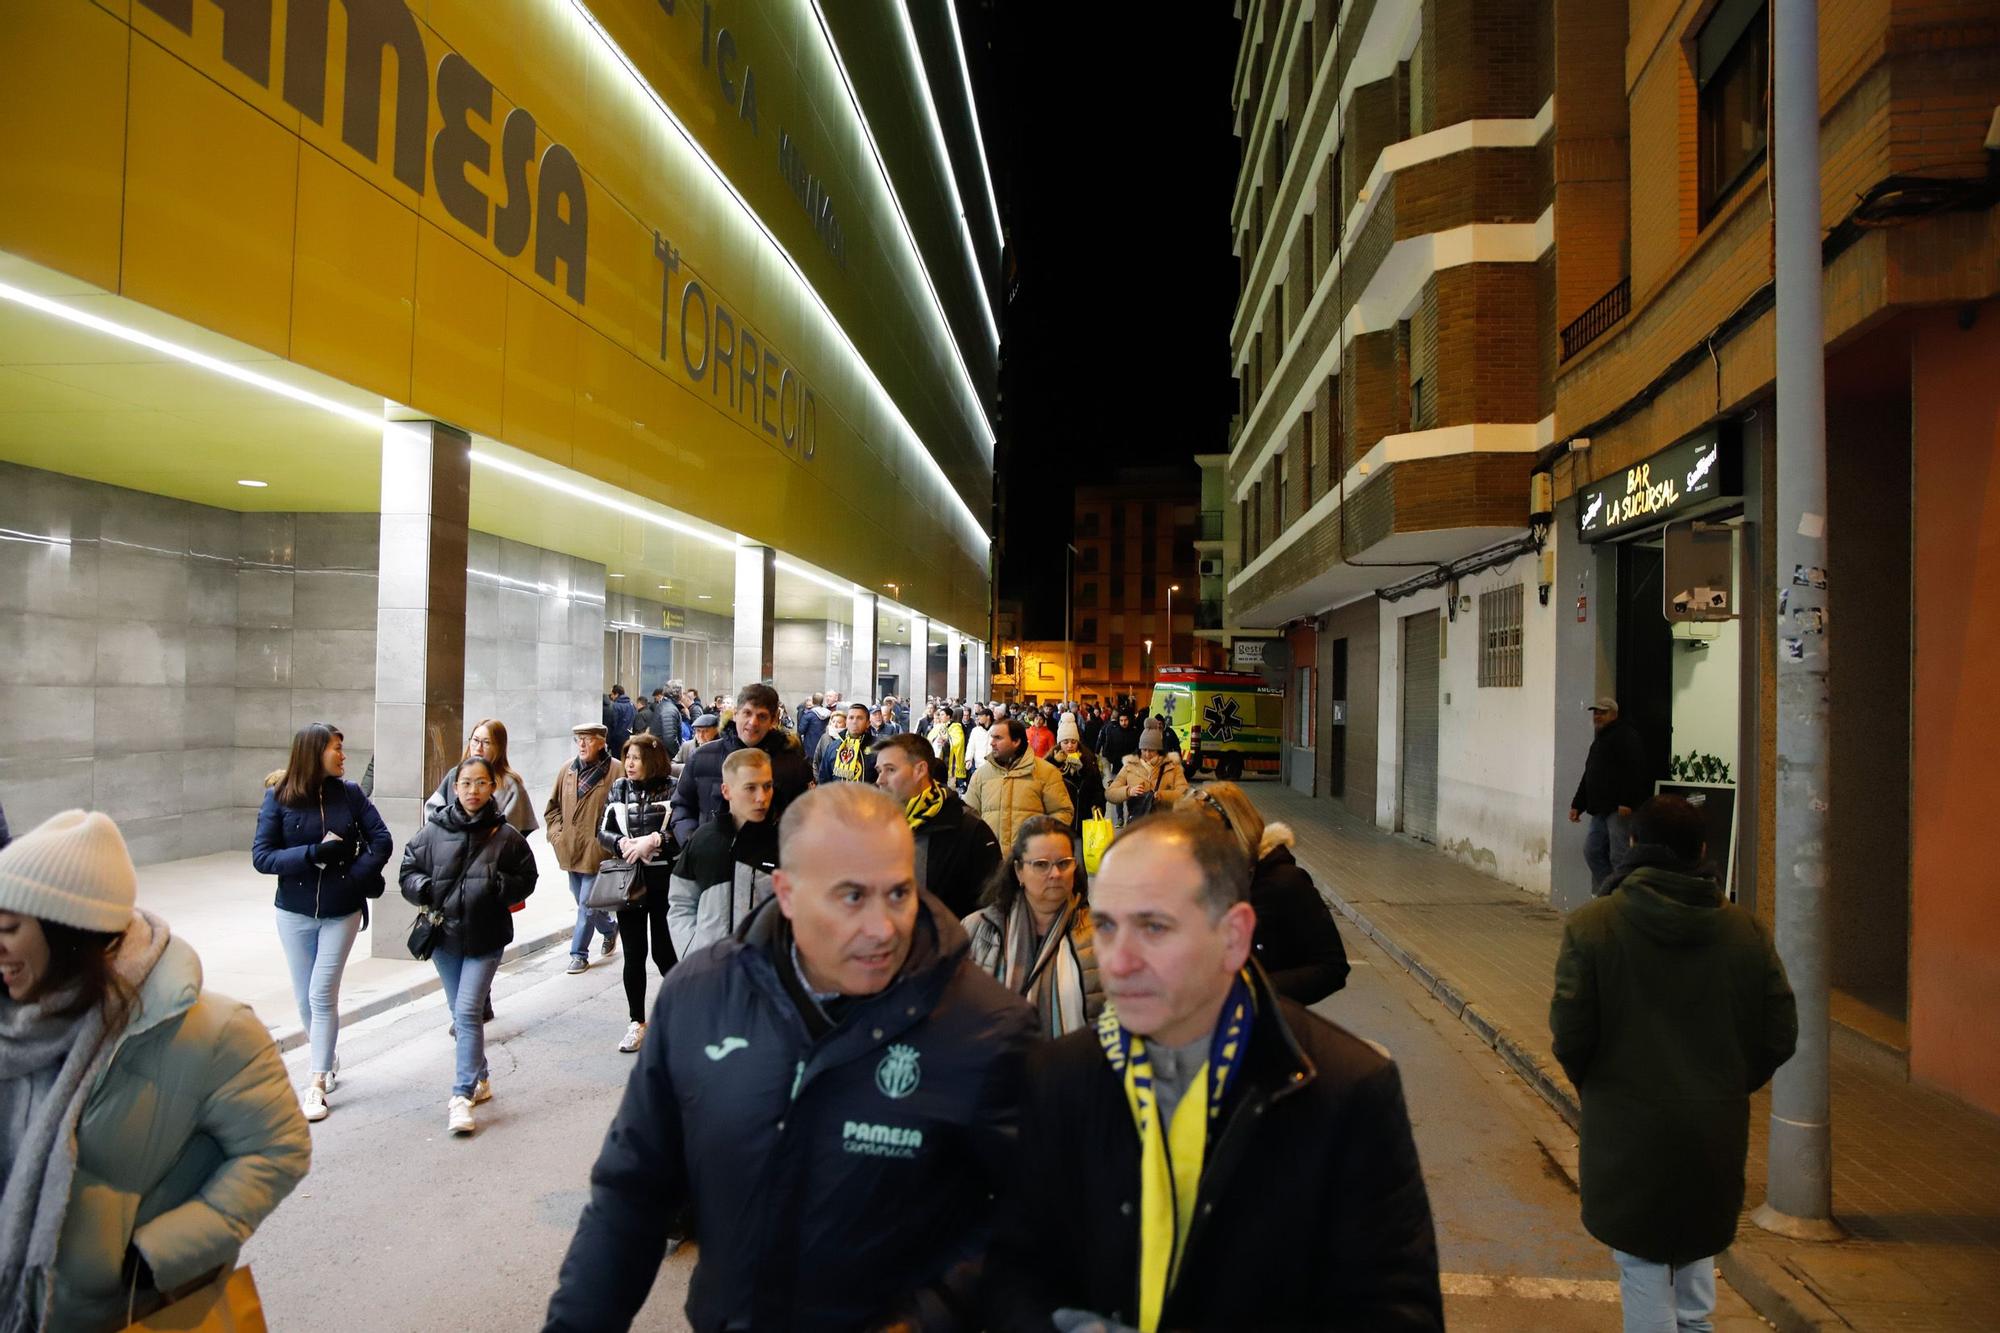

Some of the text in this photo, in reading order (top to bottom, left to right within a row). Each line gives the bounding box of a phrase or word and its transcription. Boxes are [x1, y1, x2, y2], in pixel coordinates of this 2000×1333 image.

[654, 229, 817, 462] TORRECID
[1626, 463, 1650, 494] BAR
[1606, 479, 1679, 526] LA SUCURSAL
[842, 1120, 923, 1148] PAMESA
